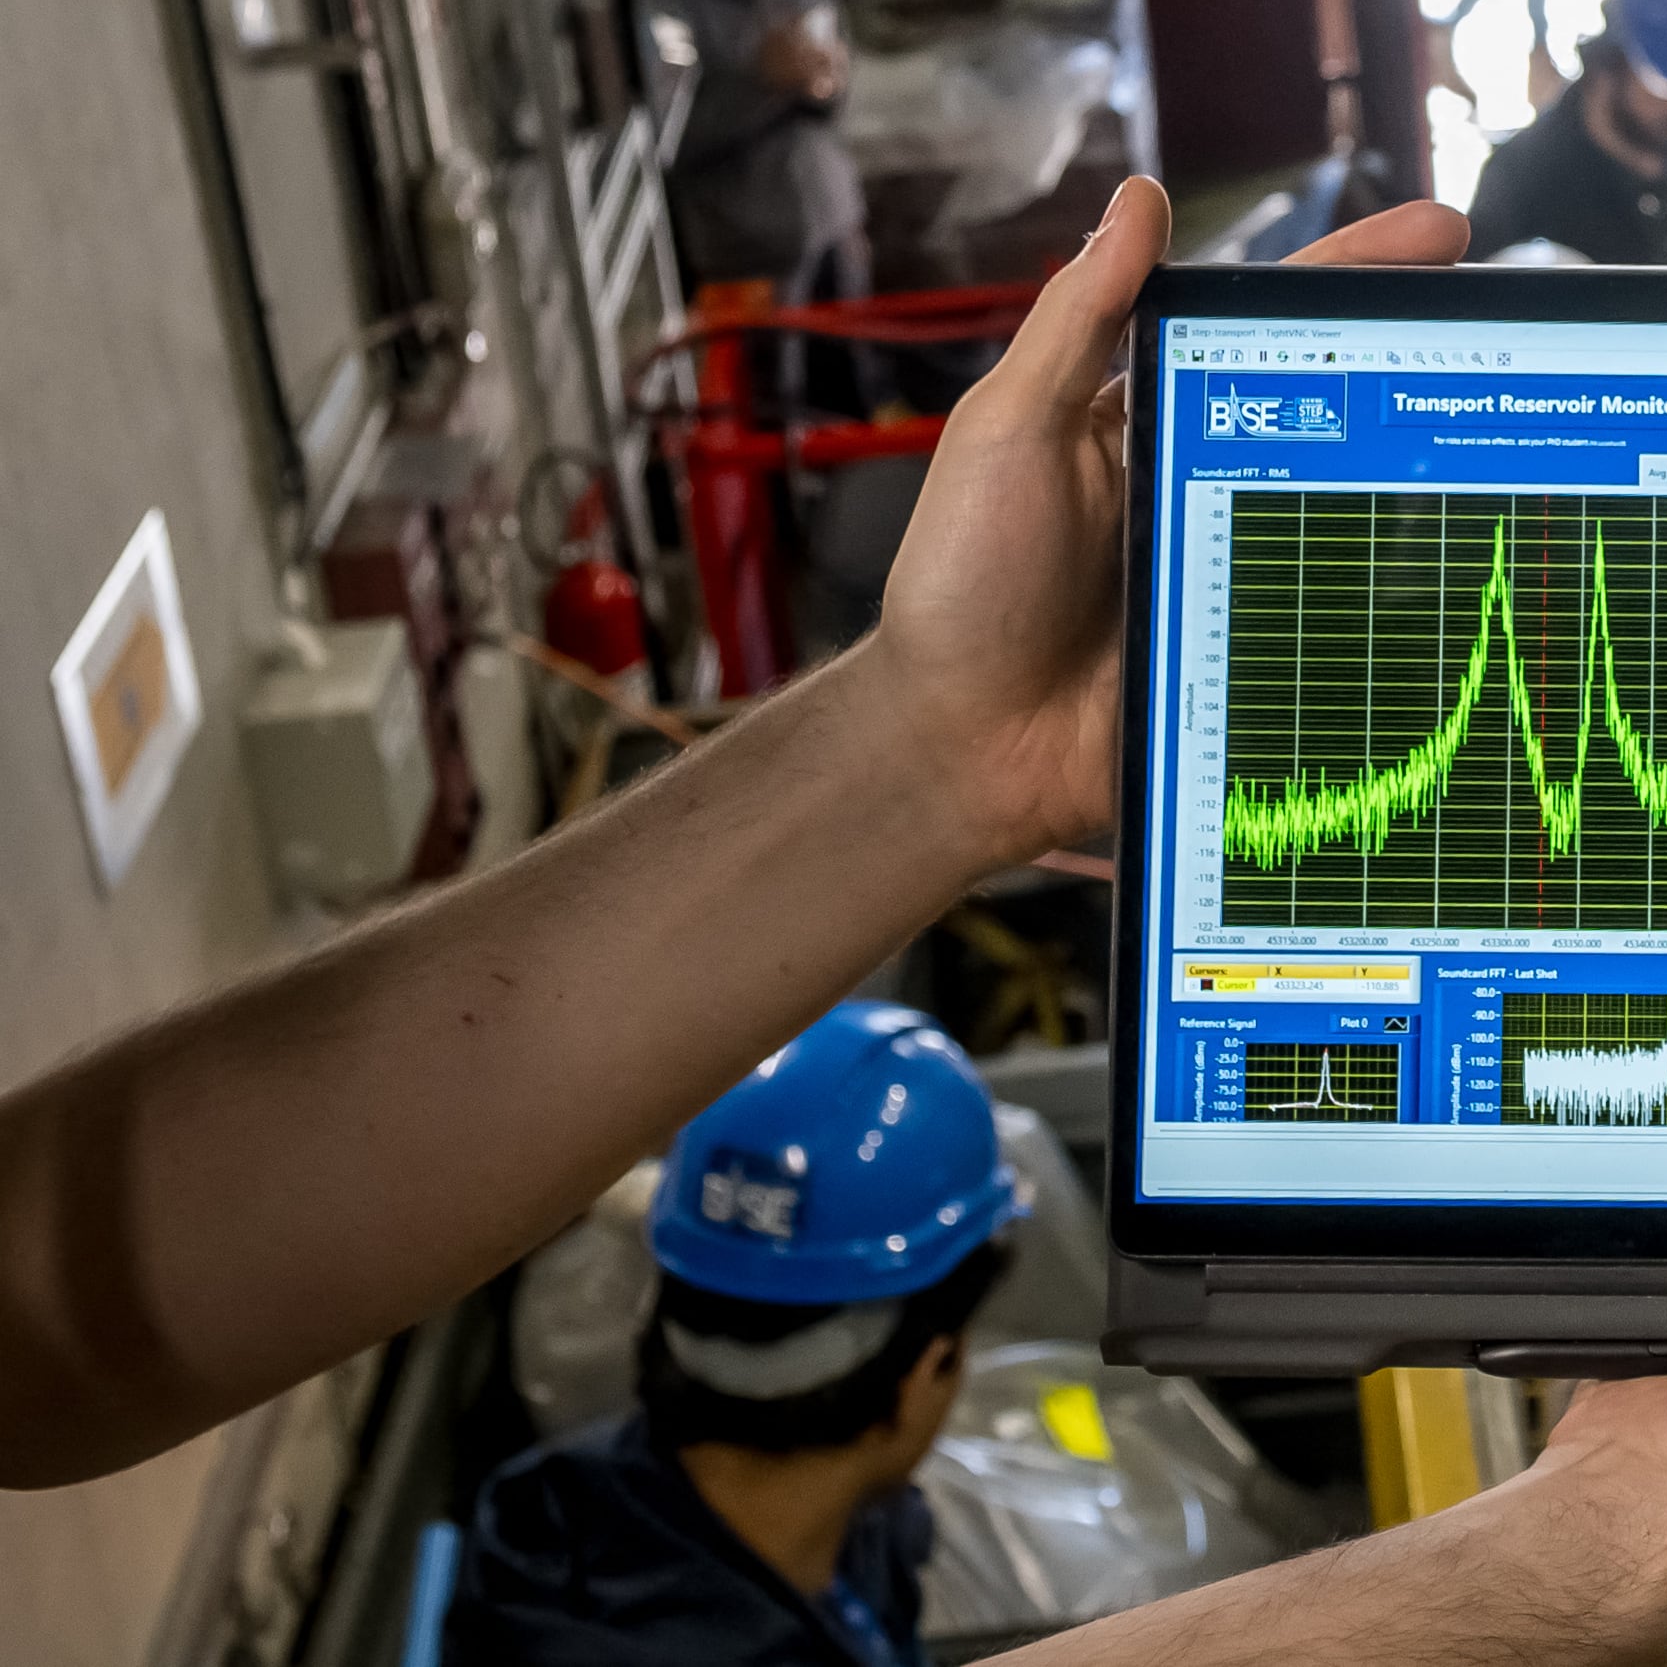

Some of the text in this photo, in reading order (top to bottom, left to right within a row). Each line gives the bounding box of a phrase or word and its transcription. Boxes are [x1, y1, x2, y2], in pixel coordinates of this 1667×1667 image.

[1266, 329, 1308, 338] TightVNC
[1311, 330, 1341, 338] Viewer
[1341, 353, 1373, 361] Ctrl Alt
[1393, 393, 1494, 417] Transport
[1500, 395, 1596, 414] Reservoir
[1299, 405, 1323, 417] STEP
[1434, 436, 1475, 445] For and
[1192, 468, 1290, 478] Soundcard FFT RMS
[1649, 469, 1666, 479] Avg
[1185, 683, 1194, 731] Amplitude
[1438, 968, 1557, 979] Soundcard FFT Last Shot
[1218, 981, 1248, 990] Cursor
[1180, 1018, 1256, 1030] Reference Signal
[1341, 1018, 1360, 1028] Plot
[1194, 1072, 1205, 1121] Amplitude
[1451, 1076, 1462, 1124] Amplitude
